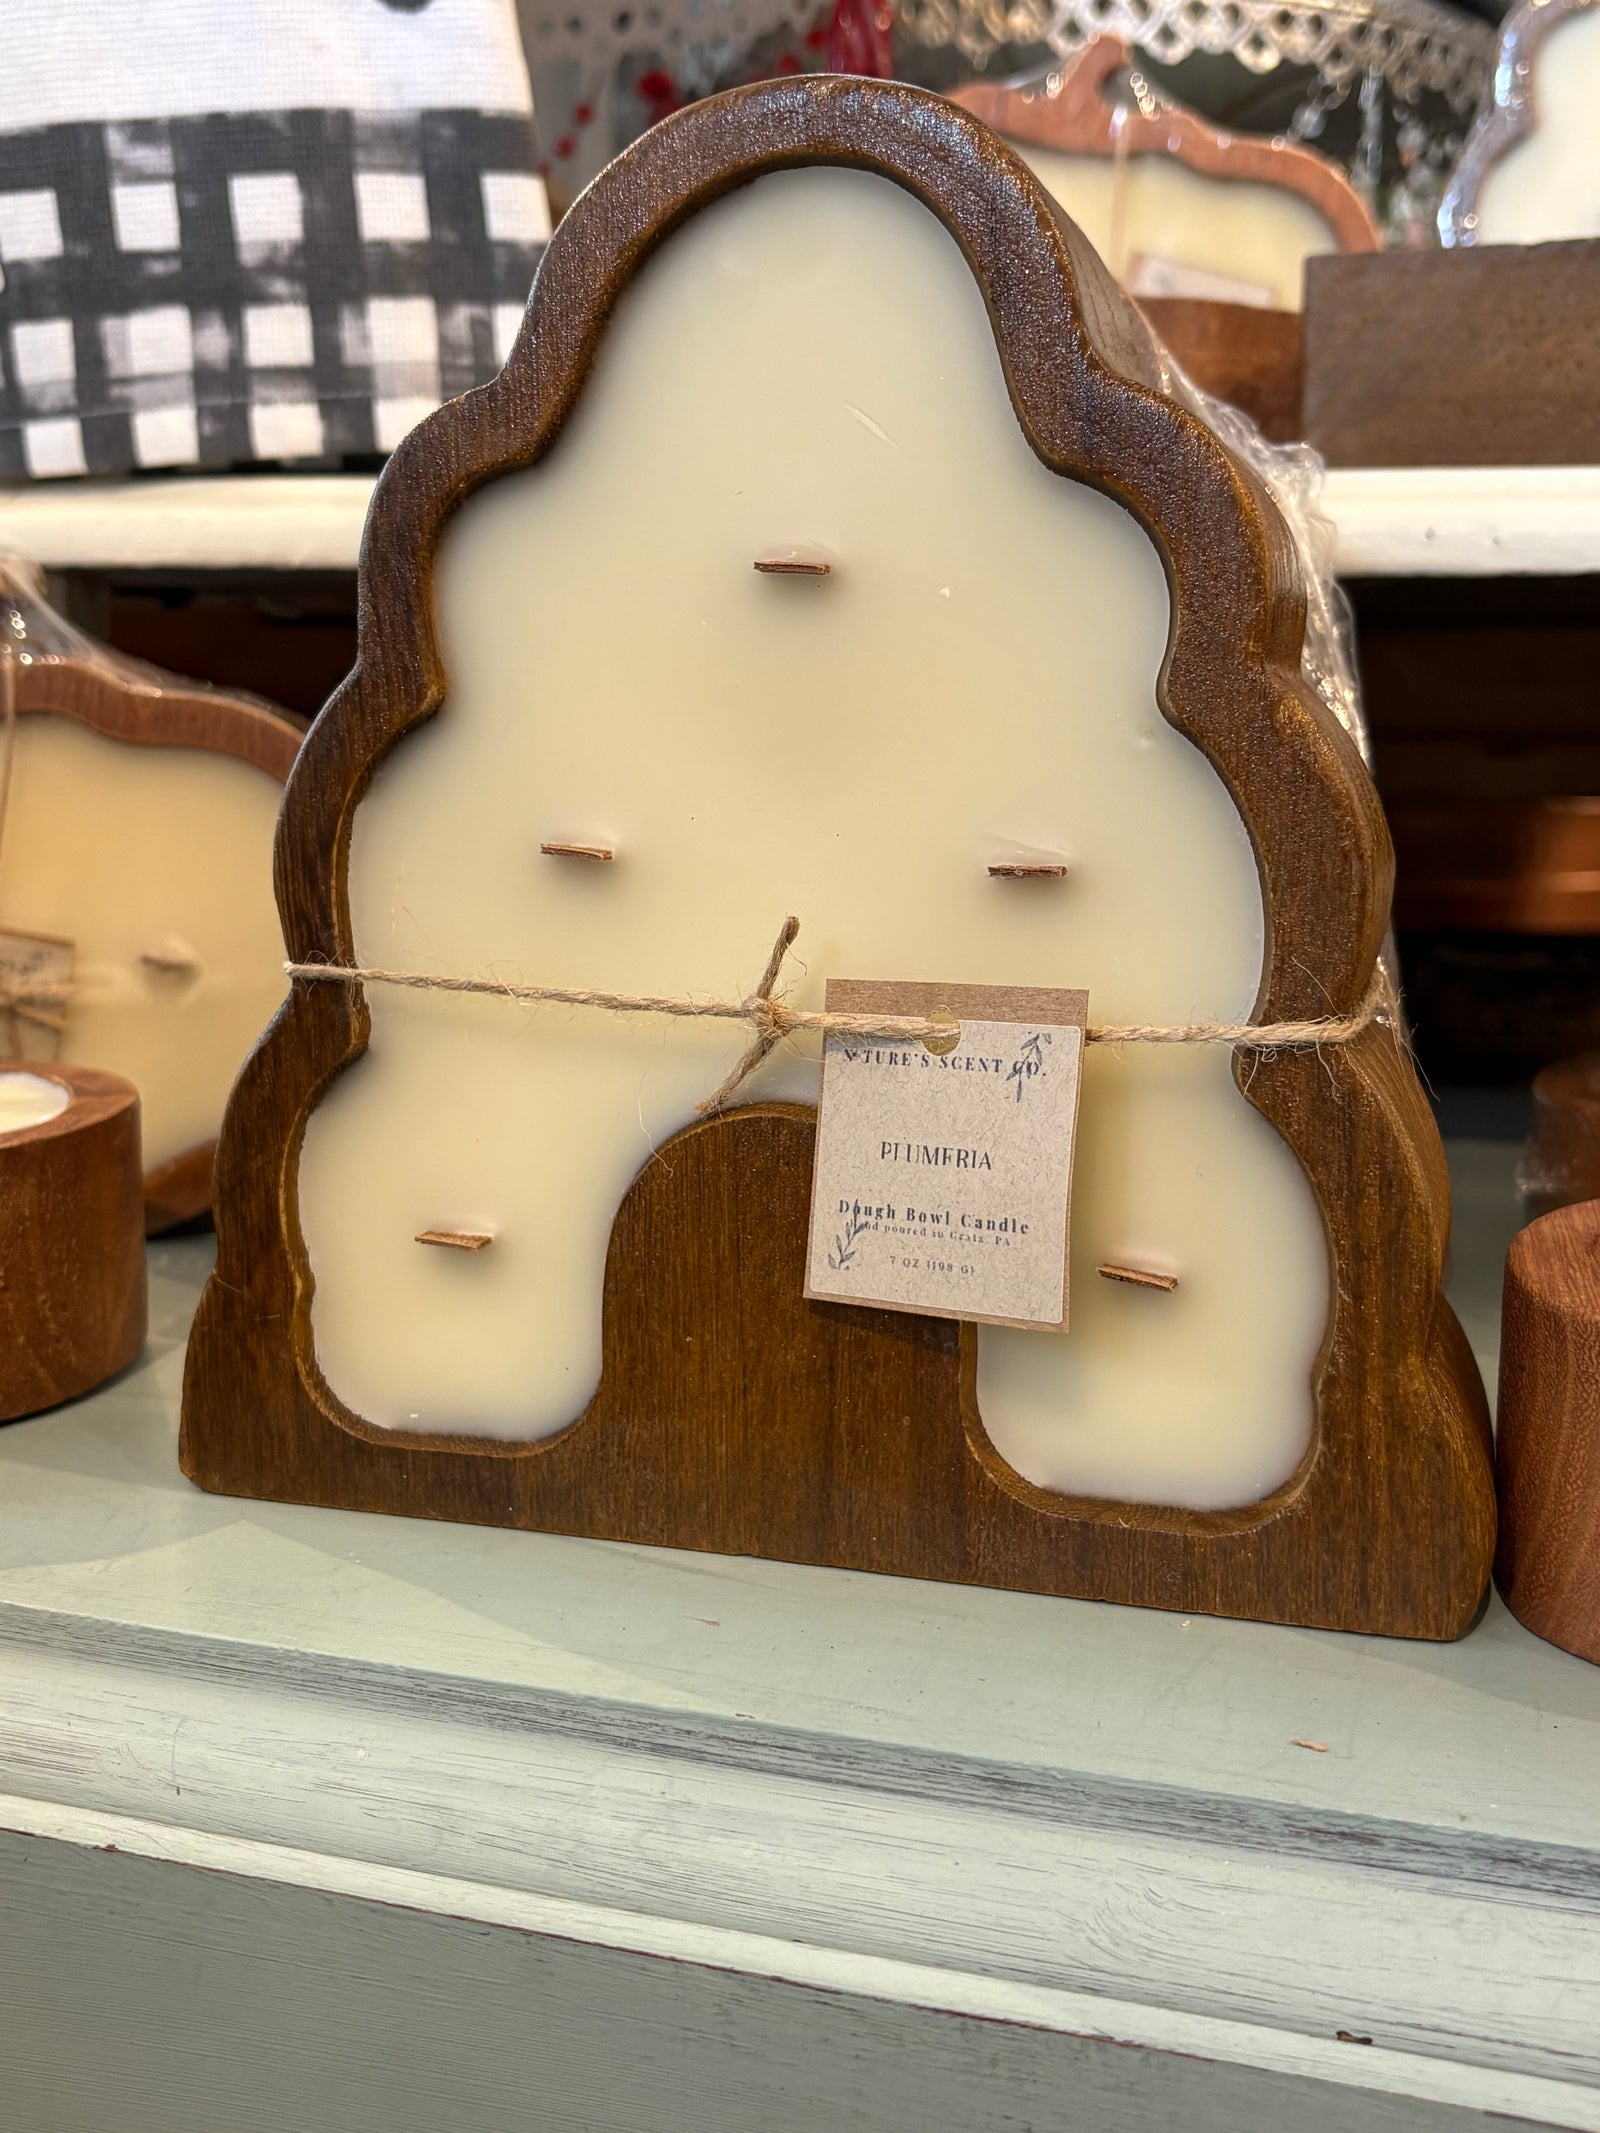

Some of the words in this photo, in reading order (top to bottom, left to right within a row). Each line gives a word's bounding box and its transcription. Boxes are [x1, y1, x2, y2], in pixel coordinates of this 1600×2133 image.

[844, 1049, 930, 1068] NTURE'S
[939, 1056, 1003, 1073] SCENT
[880, 1141, 992, 1170] PLUMERIA
[838, 1199, 896, 1220] Dough
[906, 1207, 950, 1225] Bowl
[961, 1214, 1030, 1234] Candle
[884, 1223, 926, 1237] poured
[889, 1255, 896, 1265] 7
[902, 1258, 920, 1268] OZ
